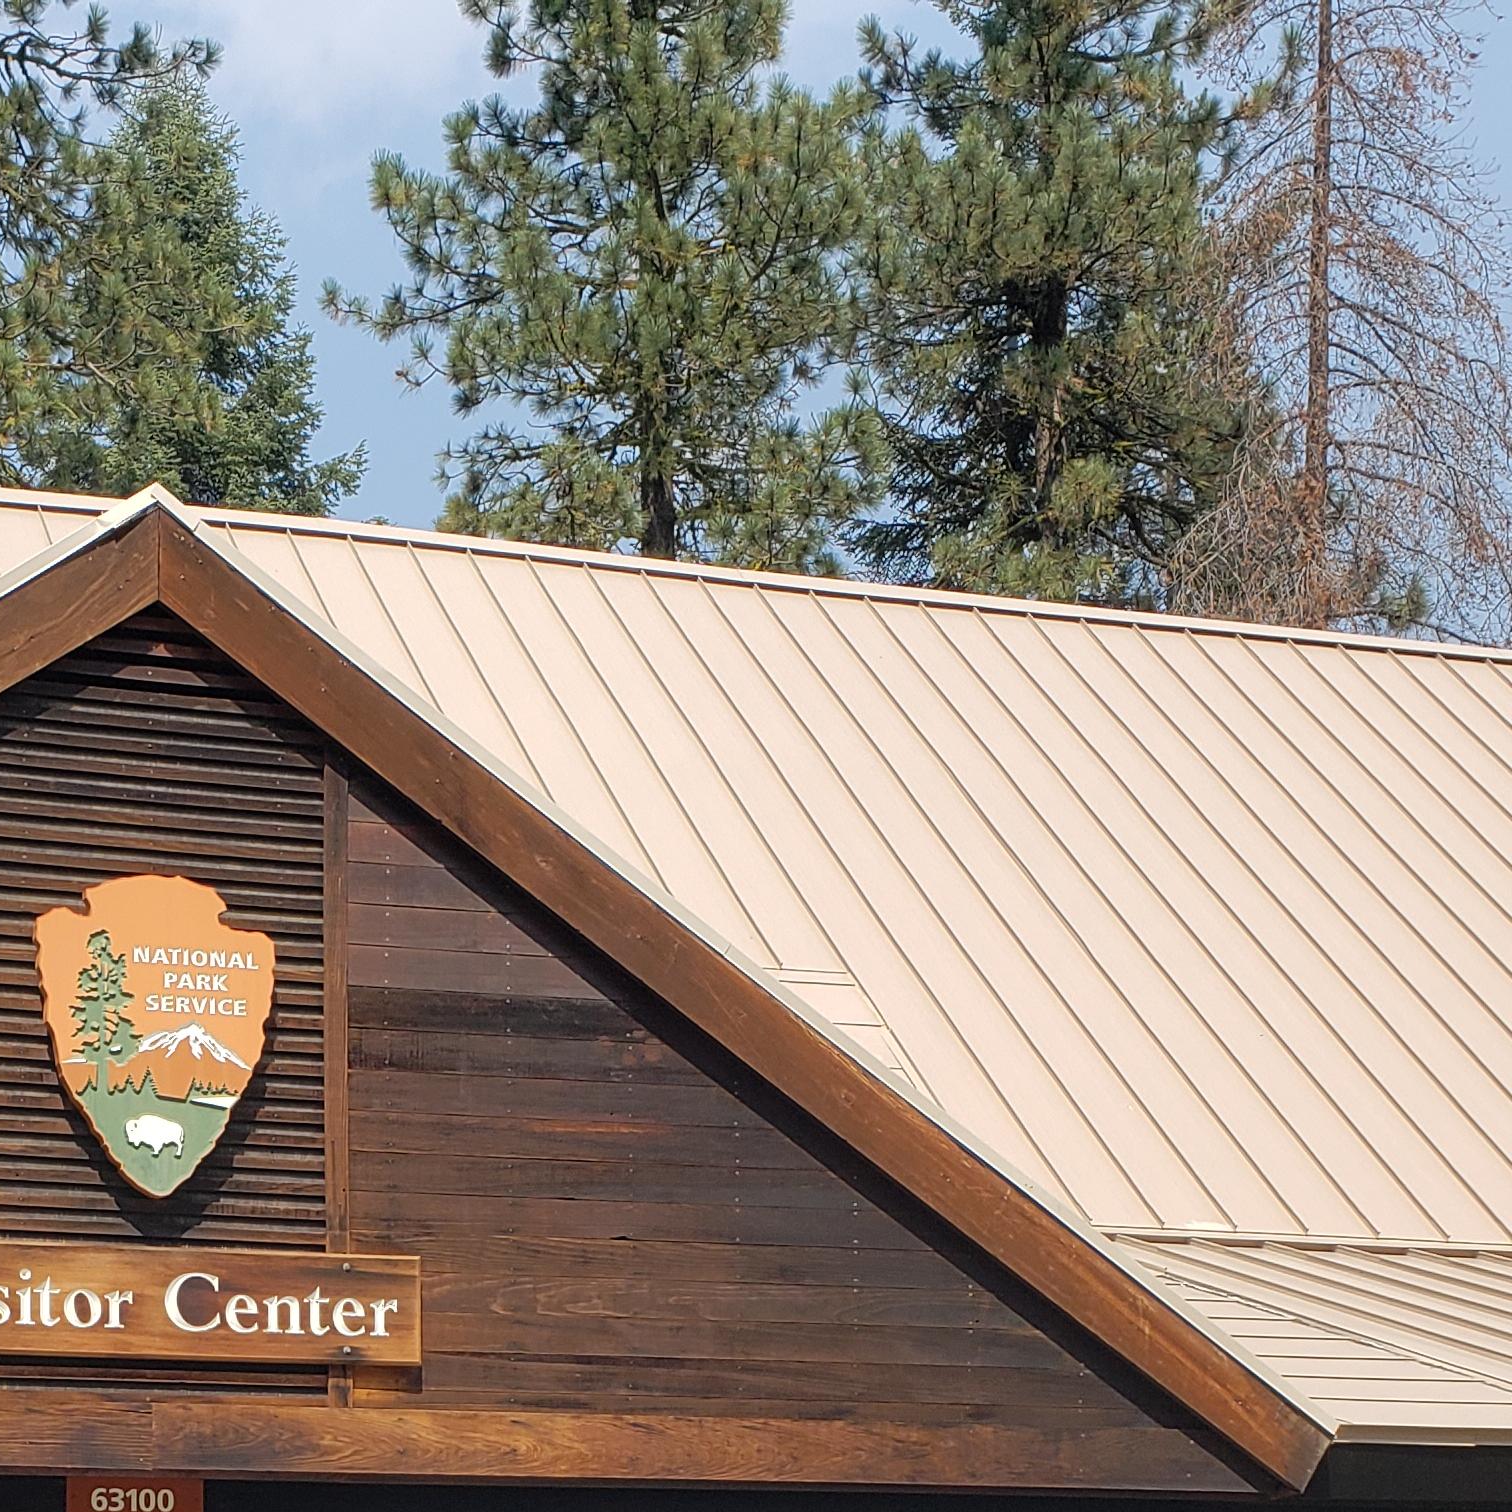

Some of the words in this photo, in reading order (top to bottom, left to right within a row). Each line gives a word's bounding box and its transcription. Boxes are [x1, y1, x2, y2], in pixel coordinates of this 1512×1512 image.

[132, 945, 259, 971] NATIONAL
[162, 971, 228, 993] PARK
[144, 993, 248, 1018] SERVICE
[164, 1272, 400, 1338] Center
